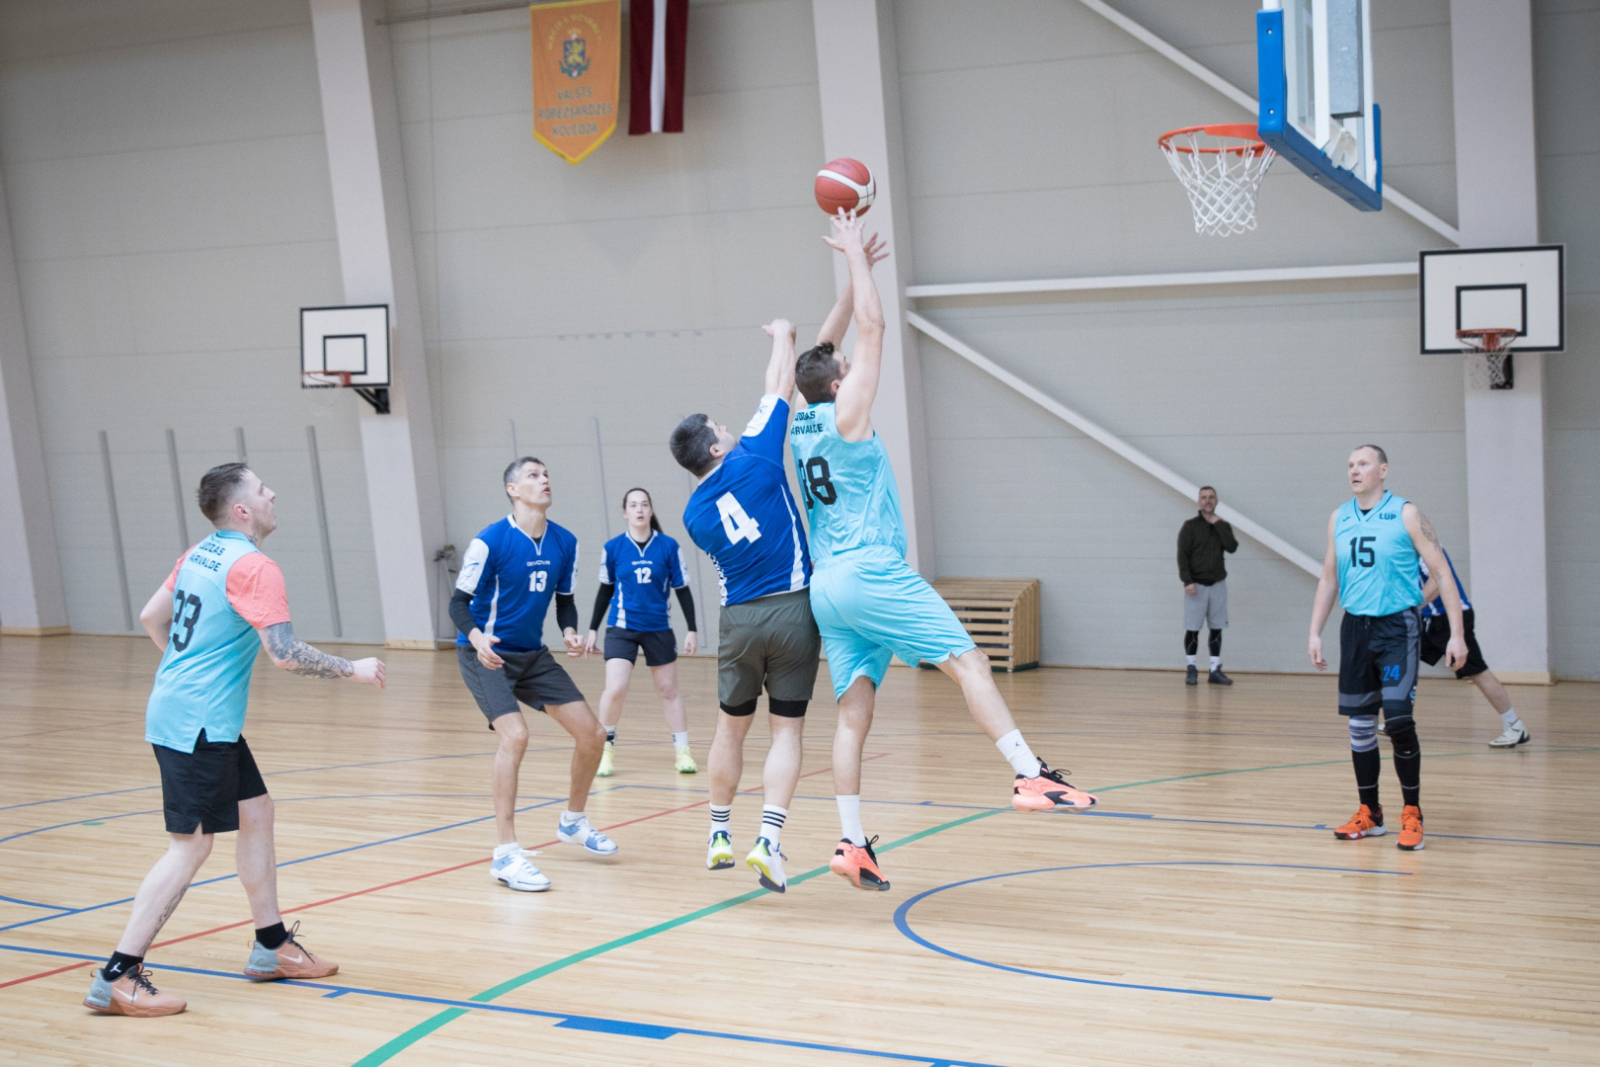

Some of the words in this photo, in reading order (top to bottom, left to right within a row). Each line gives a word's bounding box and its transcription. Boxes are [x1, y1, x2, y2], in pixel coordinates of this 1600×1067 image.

[557, 86, 593, 100] VALSTS
[715, 491, 762, 546] 4
[1379, 513, 1397, 521] LUP
[1349, 536, 1376, 568] 15
[528, 570, 548, 593] 13
[633, 567, 652, 584] 12
[1383, 664, 1400, 681] 24
